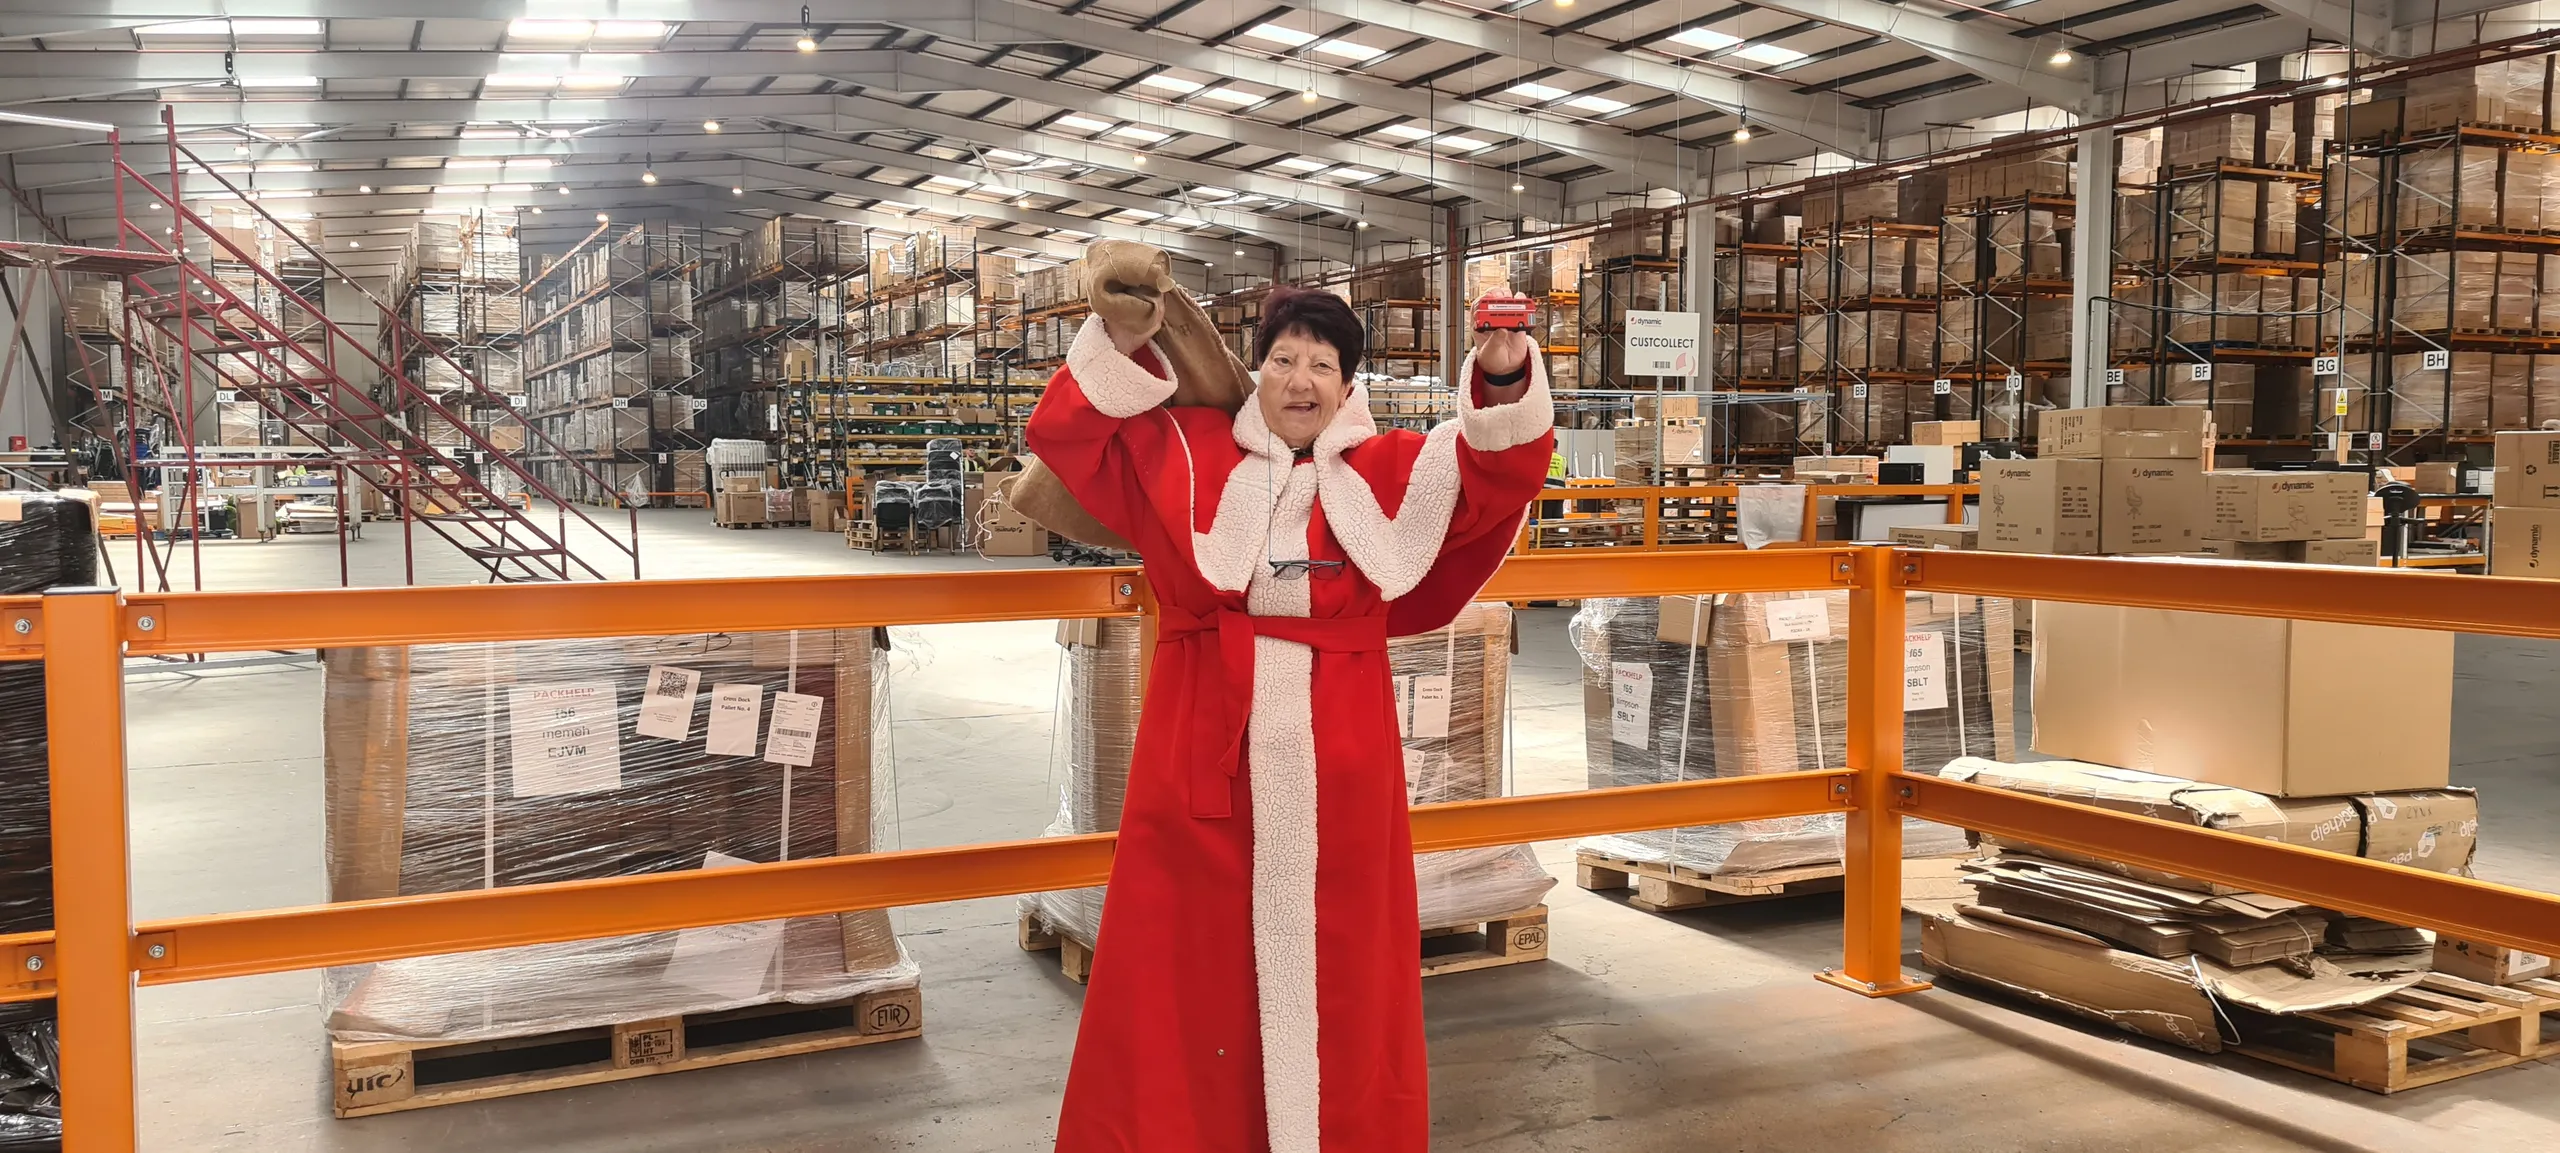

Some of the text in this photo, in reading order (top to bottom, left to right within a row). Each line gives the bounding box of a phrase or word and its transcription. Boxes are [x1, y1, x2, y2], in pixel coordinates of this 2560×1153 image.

[1637, 317, 1662, 326] dynamic
[1630, 336, 1694, 348] CUSTCOLLECT
[2317, 359, 2335, 372] BG
[2427, 353, 2445, 367] BH
[2106, 371, 2120, 382] BE
[2194, 366, 2208, 378] BF
[1855, 385, 1865, 396] BB
[1936, 381, 1949, 392] BC
[219, 392, 232, 401] DL
[514, 397, 523, 405] DI
[614, 399, 627, 407] DH
[693, 400, 706, 408] DG
[2006, 469, 2031, 478] dynamic
[2142, 468, 2174, 478] dynamic
[2281, 480, 2314, 491] dynamic
[2530, 524, 2540, 558] dynamic
[1904, 633, 1931, 642] ACKHELP
[1906, 677, 1928, 688] SBLT
[533, 687, 595, 699] PACKHELP
[1616, 710, 1635, 723] SBLT
[547, 745, 587, 758] EJVM
[1518, 931, 1542, 946] EPAL
